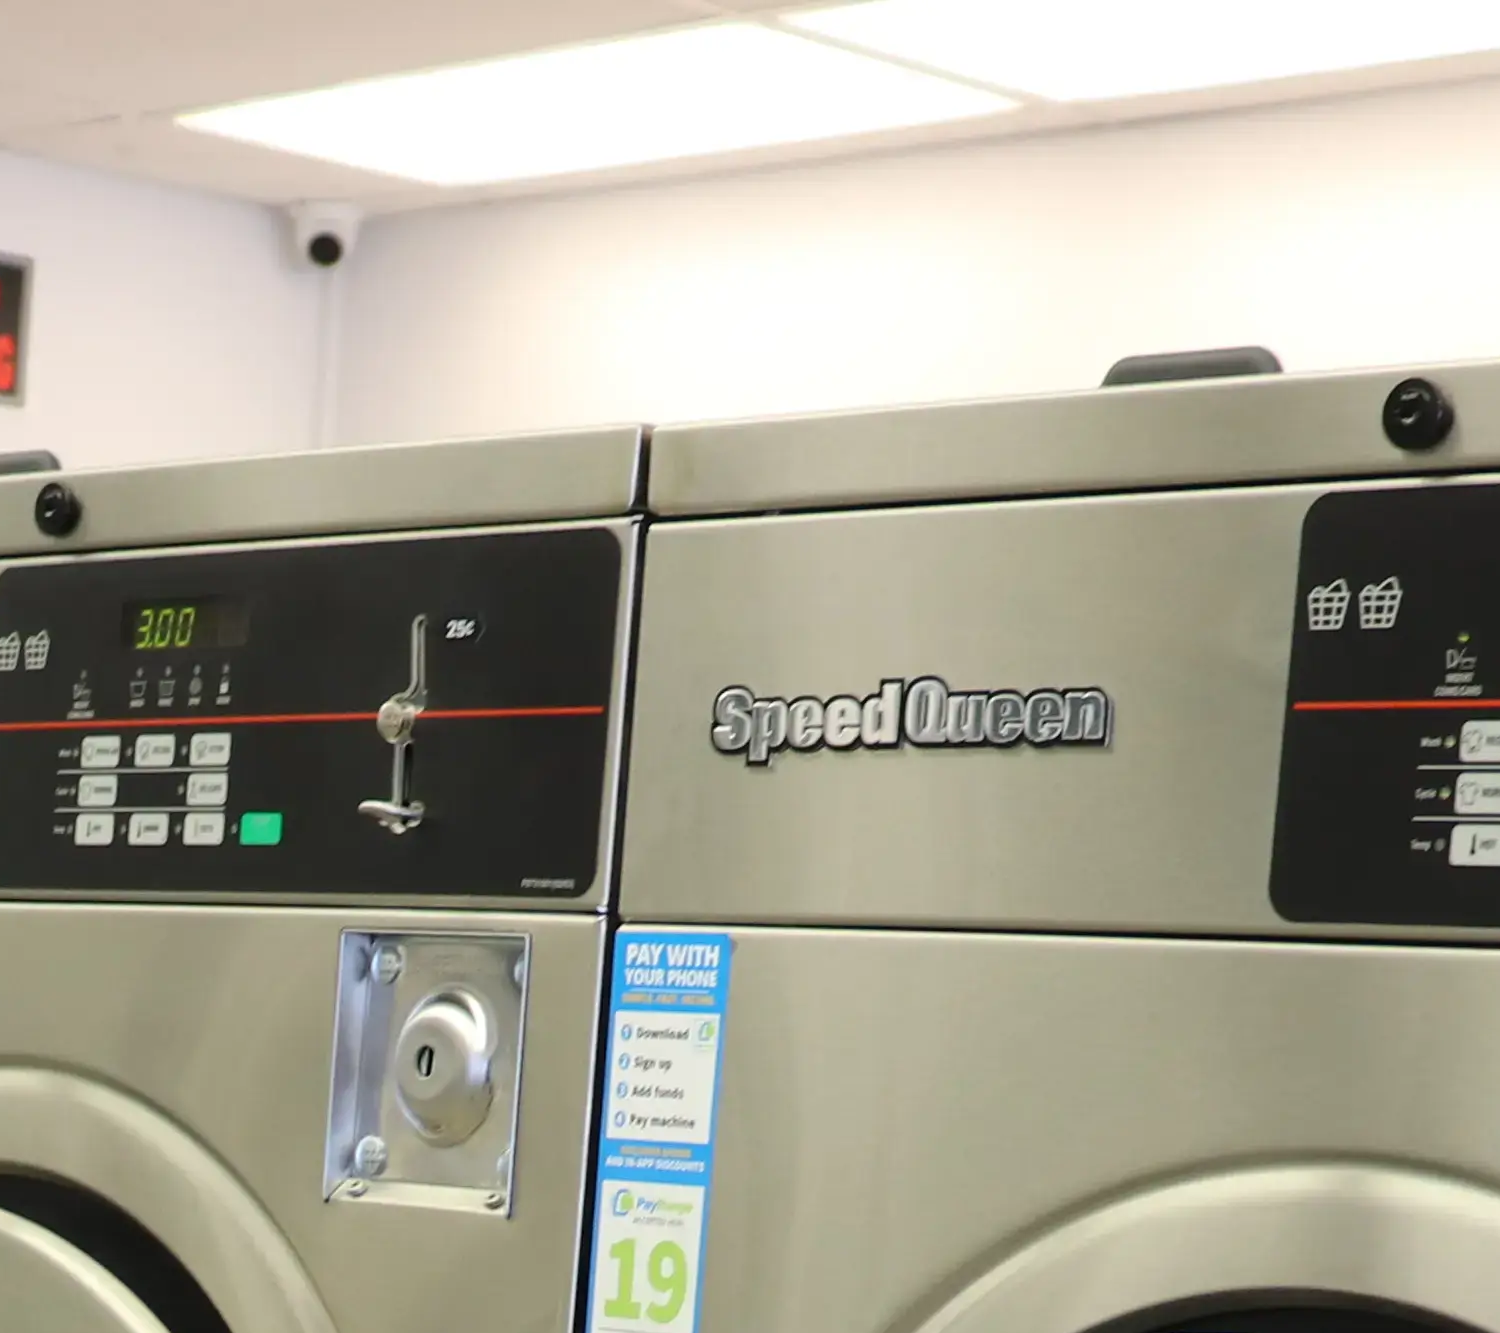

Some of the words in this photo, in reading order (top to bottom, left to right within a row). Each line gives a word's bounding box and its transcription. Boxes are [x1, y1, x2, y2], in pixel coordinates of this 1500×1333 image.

[136, 607, 196, 649] 3.00
[711, 678, 901, 767] Speed
[903, 675, 1108, 749] Queen
[625, 943, 665, 966] PAY
[667, 943, 720, 968] WITH
[624, 967, 665, 987] YOUR
[667, 968, 719, 989] PHONE
[636, 1026, 691, 1041] Download
[633, 1055, 656, 1072] Sign
[658, 1059, 673, 1075] up
[630, 1085, 652, 1098] Add
[653, 1085, 685, 1100] funds
[628, 1113, 648, 1129] Pay
[650, 1114, 696, 1129] machine
[604, 1237, 688, 1325] 19
